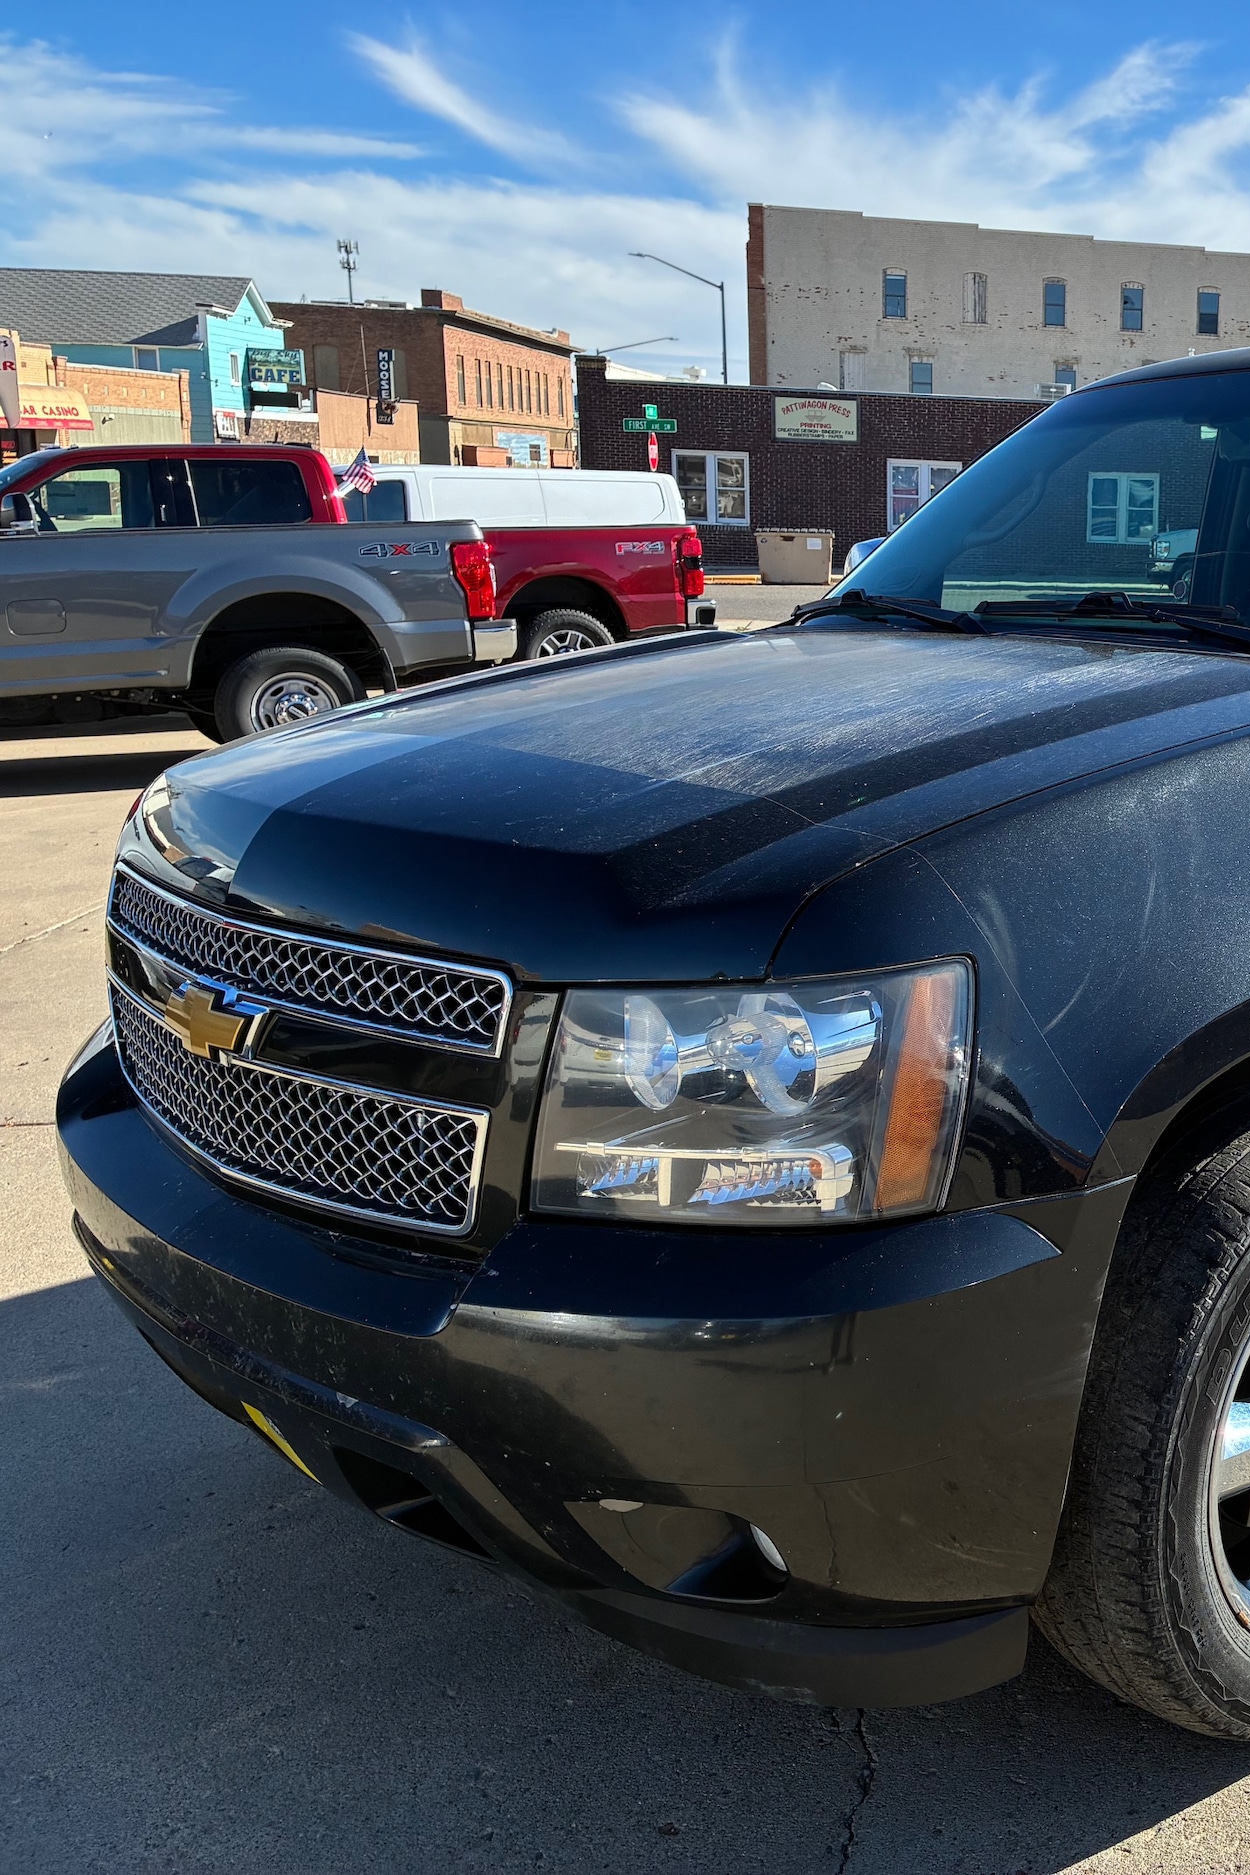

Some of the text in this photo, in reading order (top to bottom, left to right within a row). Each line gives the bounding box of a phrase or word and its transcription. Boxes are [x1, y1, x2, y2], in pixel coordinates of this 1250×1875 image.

[250, 367, 300, 383] CAFE
[378, 351, 390, 399] MOOSE
[20, 405, 79, 417] AR CASINO
[781, 400, 851, 418] PATTIWAGON PRESS
[628, 420, 647, 430] FIRST
[615, 541, 665, 555] FX4
